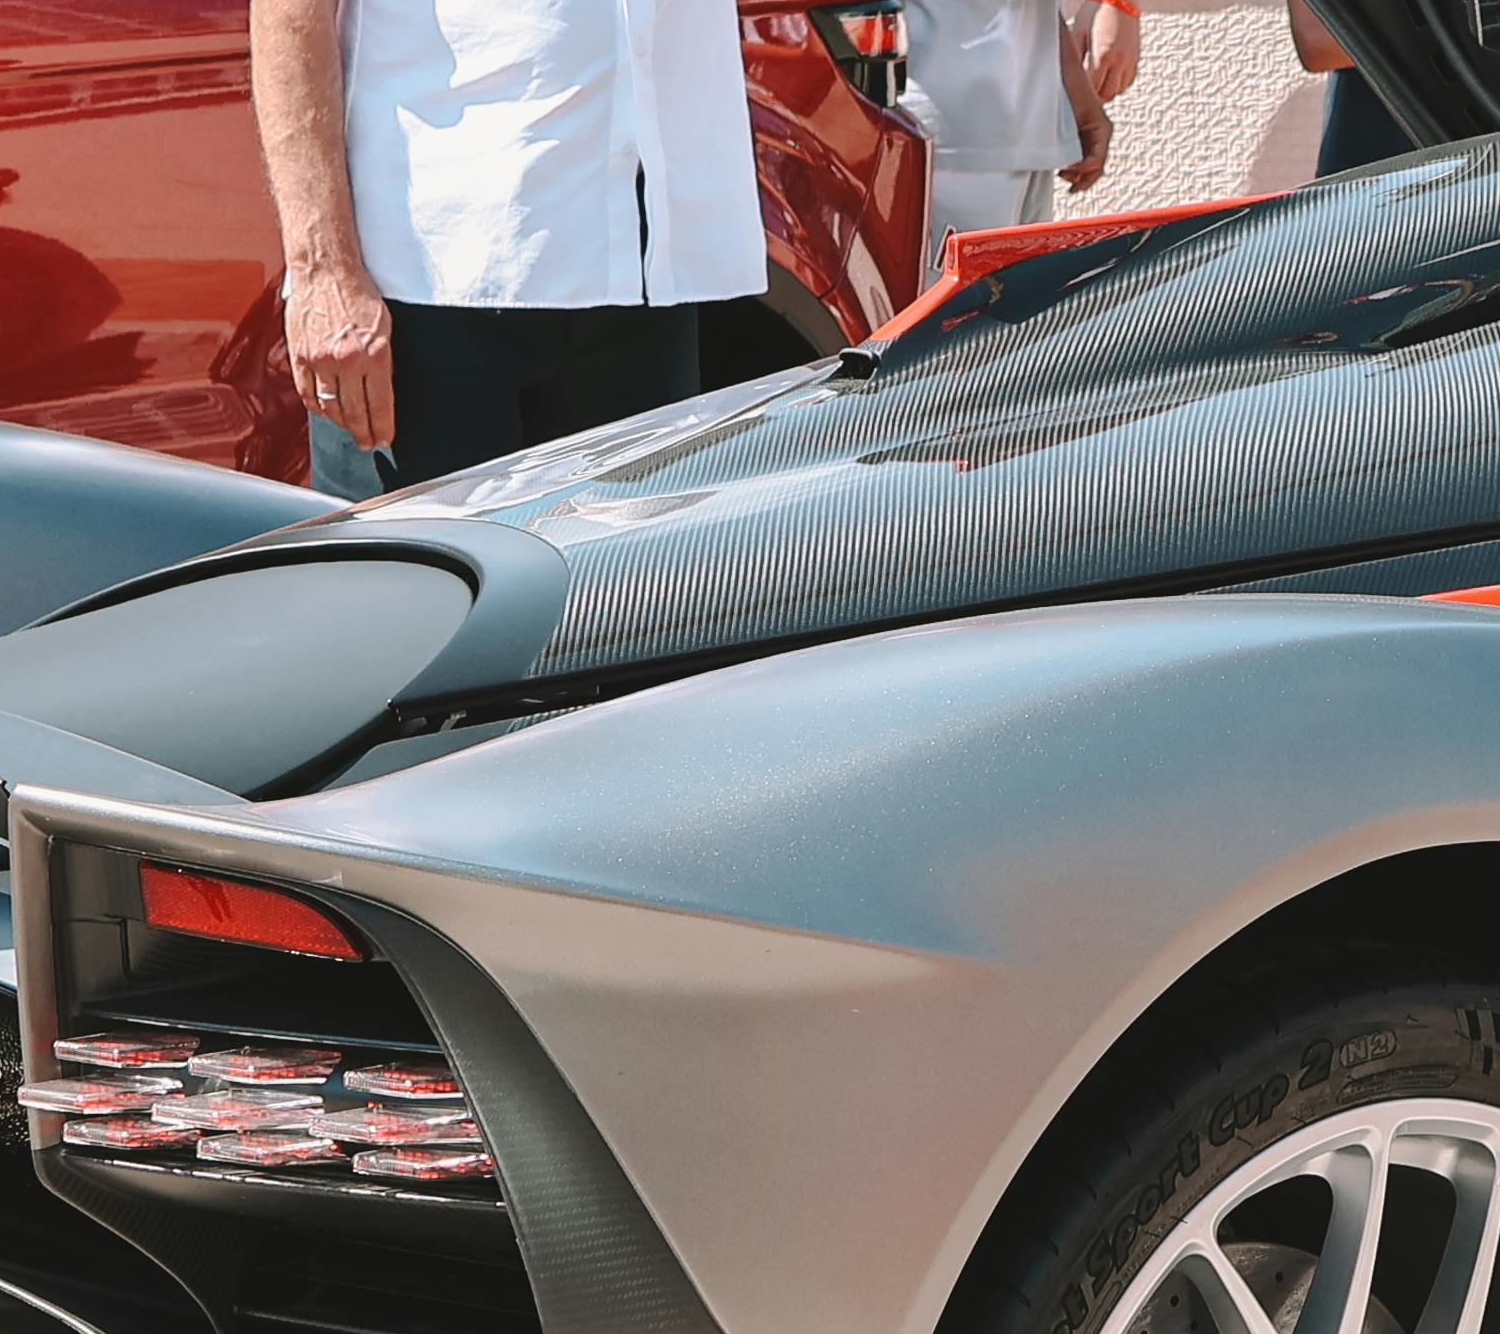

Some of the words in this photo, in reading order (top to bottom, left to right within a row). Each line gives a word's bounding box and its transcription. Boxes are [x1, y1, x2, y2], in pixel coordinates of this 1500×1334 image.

[1087, 1130, 1200, 1300] Sport
[1208, 1074, 1290, 1148] Cup
[1298, 1037, 1334, 1092] 2
